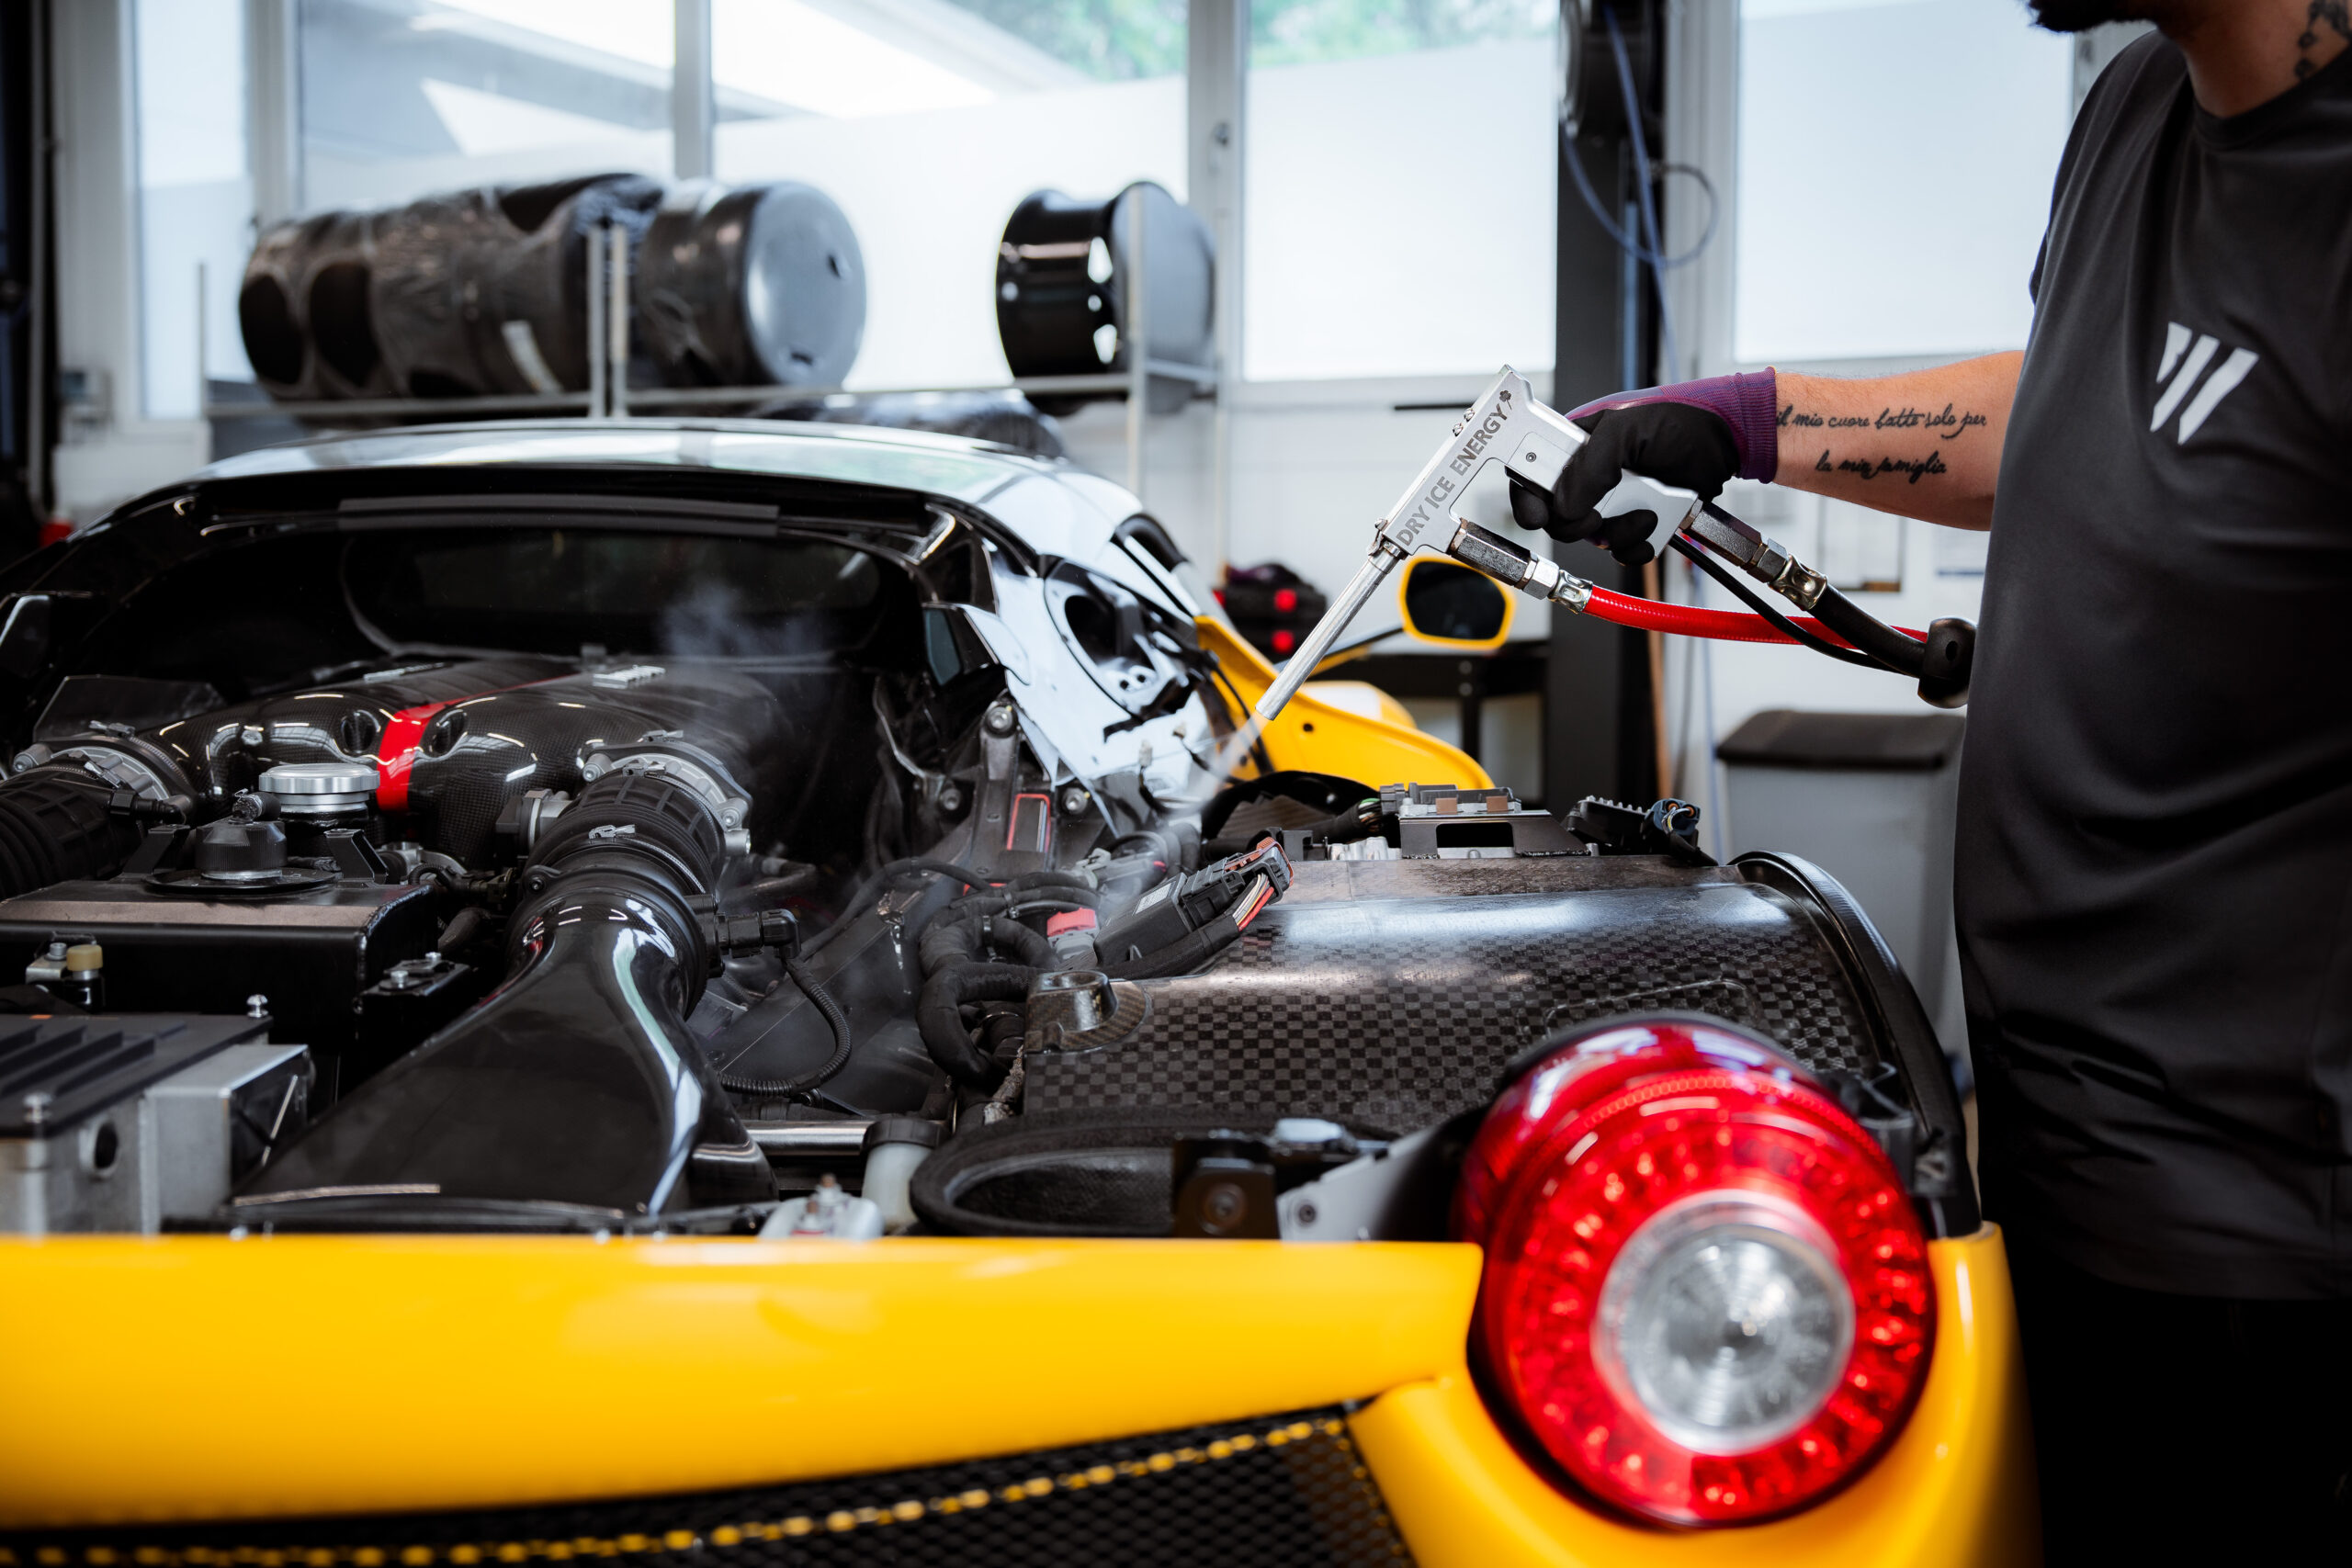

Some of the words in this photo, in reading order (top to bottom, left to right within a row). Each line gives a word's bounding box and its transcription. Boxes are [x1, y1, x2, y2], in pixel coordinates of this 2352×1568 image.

[1792, 413, 1824, 427] mio
[1827, 416, 1870, 428] cuore
[1874, 408, 1925, 430] batte
[1925, 402, 1957, 429] solo
[1940, 411, 1986, 439] per
[1396, 505, 1430, 547] DRY
[1424, 476, 1455, 509] ICE
[1449, 402, 1510, 477] ENERGY
[1815, 449, 1833, 472] la
[1838, 458, 1872, 473] mia
[1861, 450, 1947, 484] famiglia
